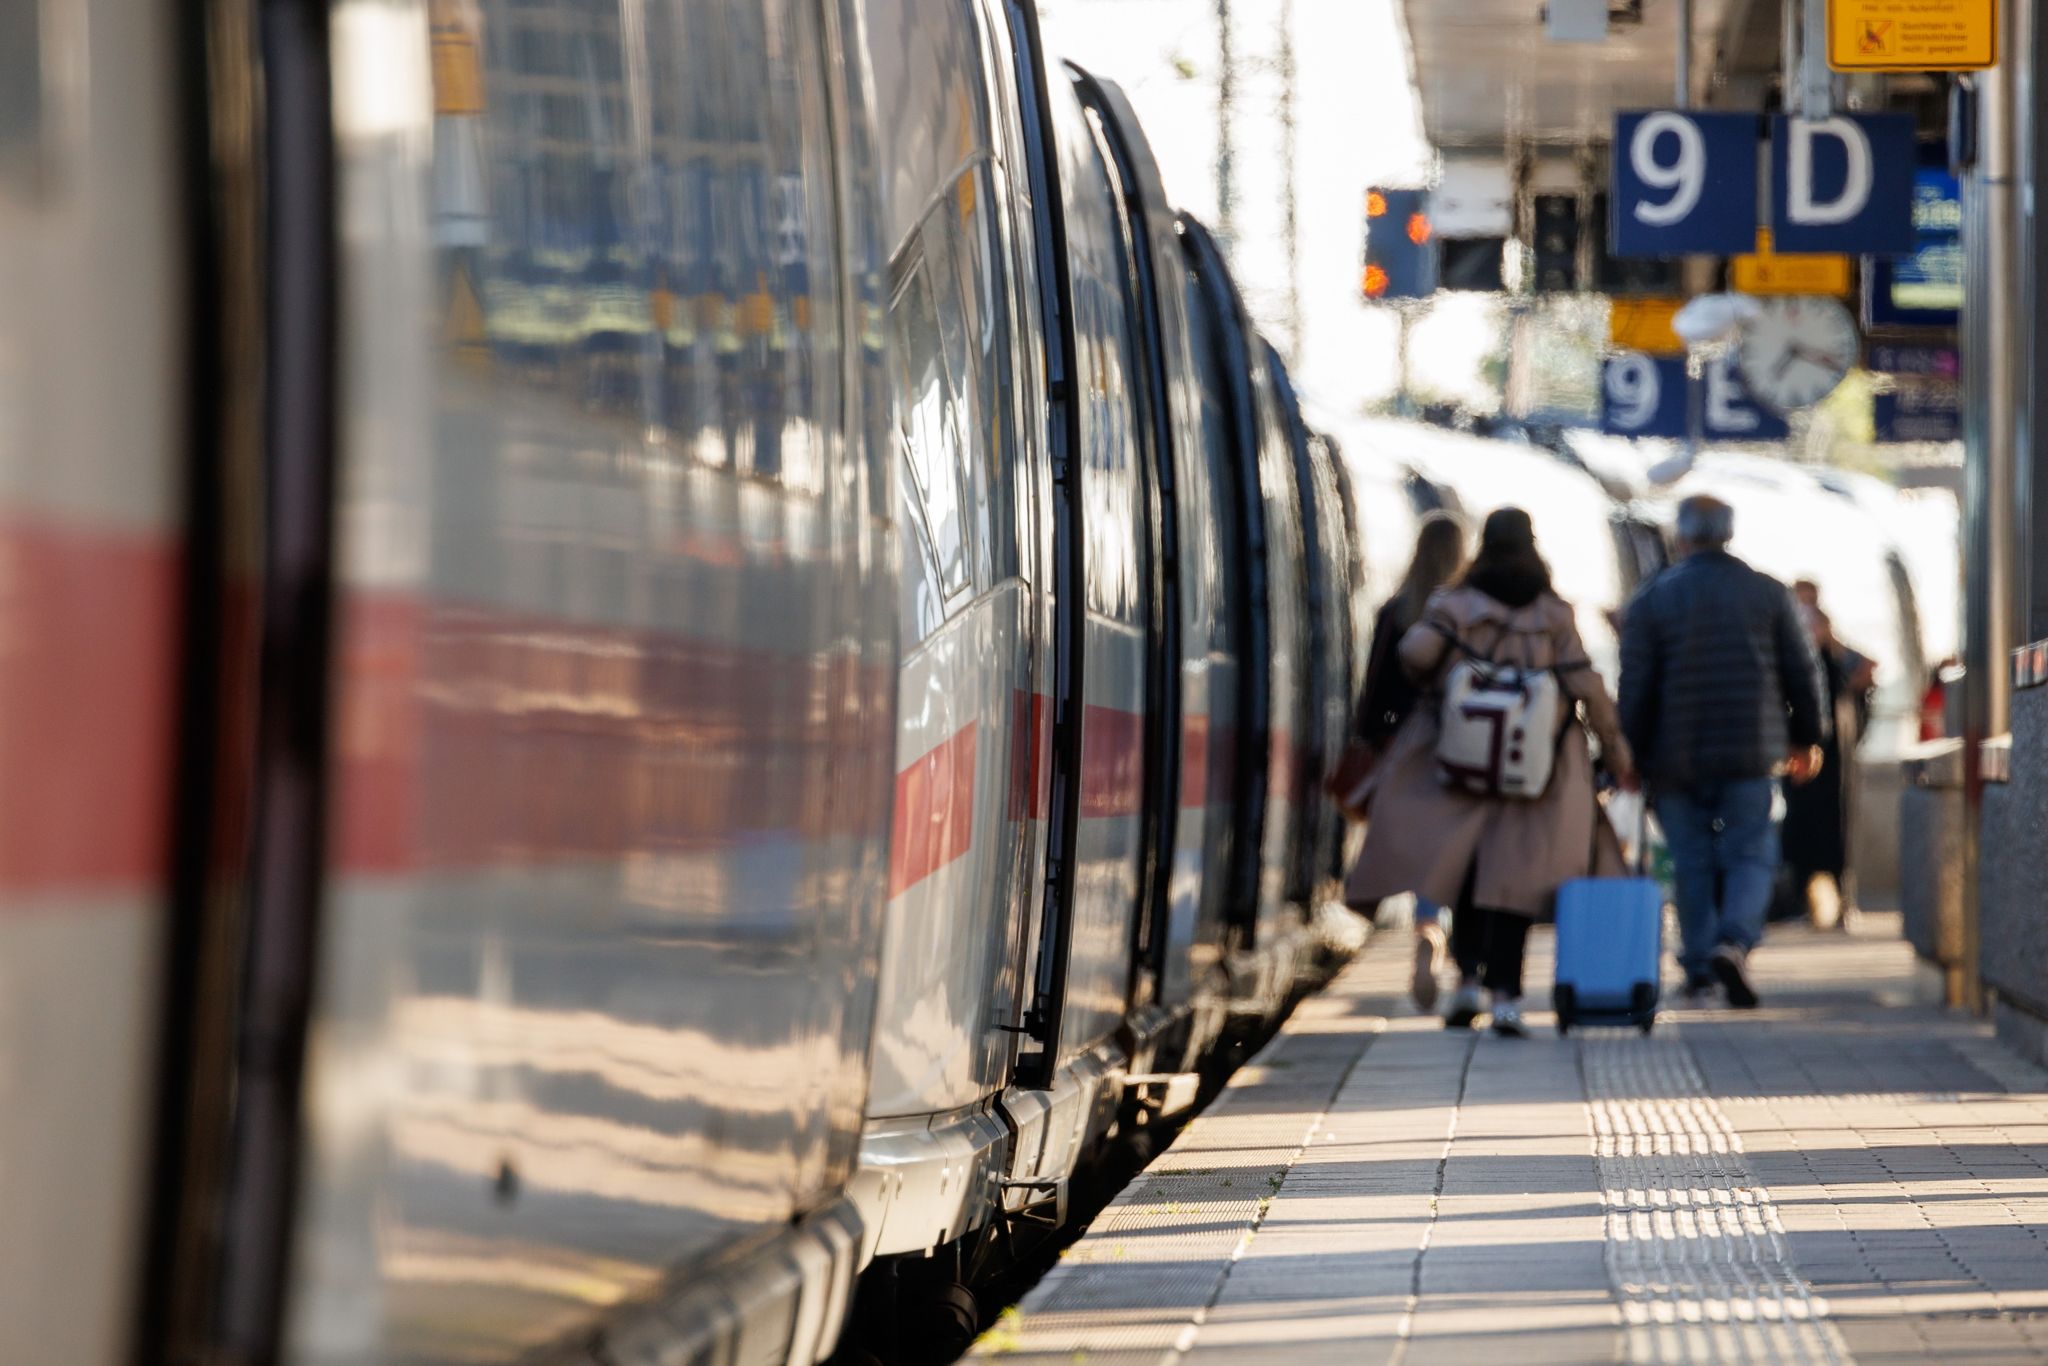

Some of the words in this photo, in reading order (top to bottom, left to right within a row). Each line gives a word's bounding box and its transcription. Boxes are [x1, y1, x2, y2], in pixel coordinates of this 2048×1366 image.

[1631, 110, 1706, 226] 9
[1786, 116, 1873, 225] D
[1606, 354, 1661, 429] 9
